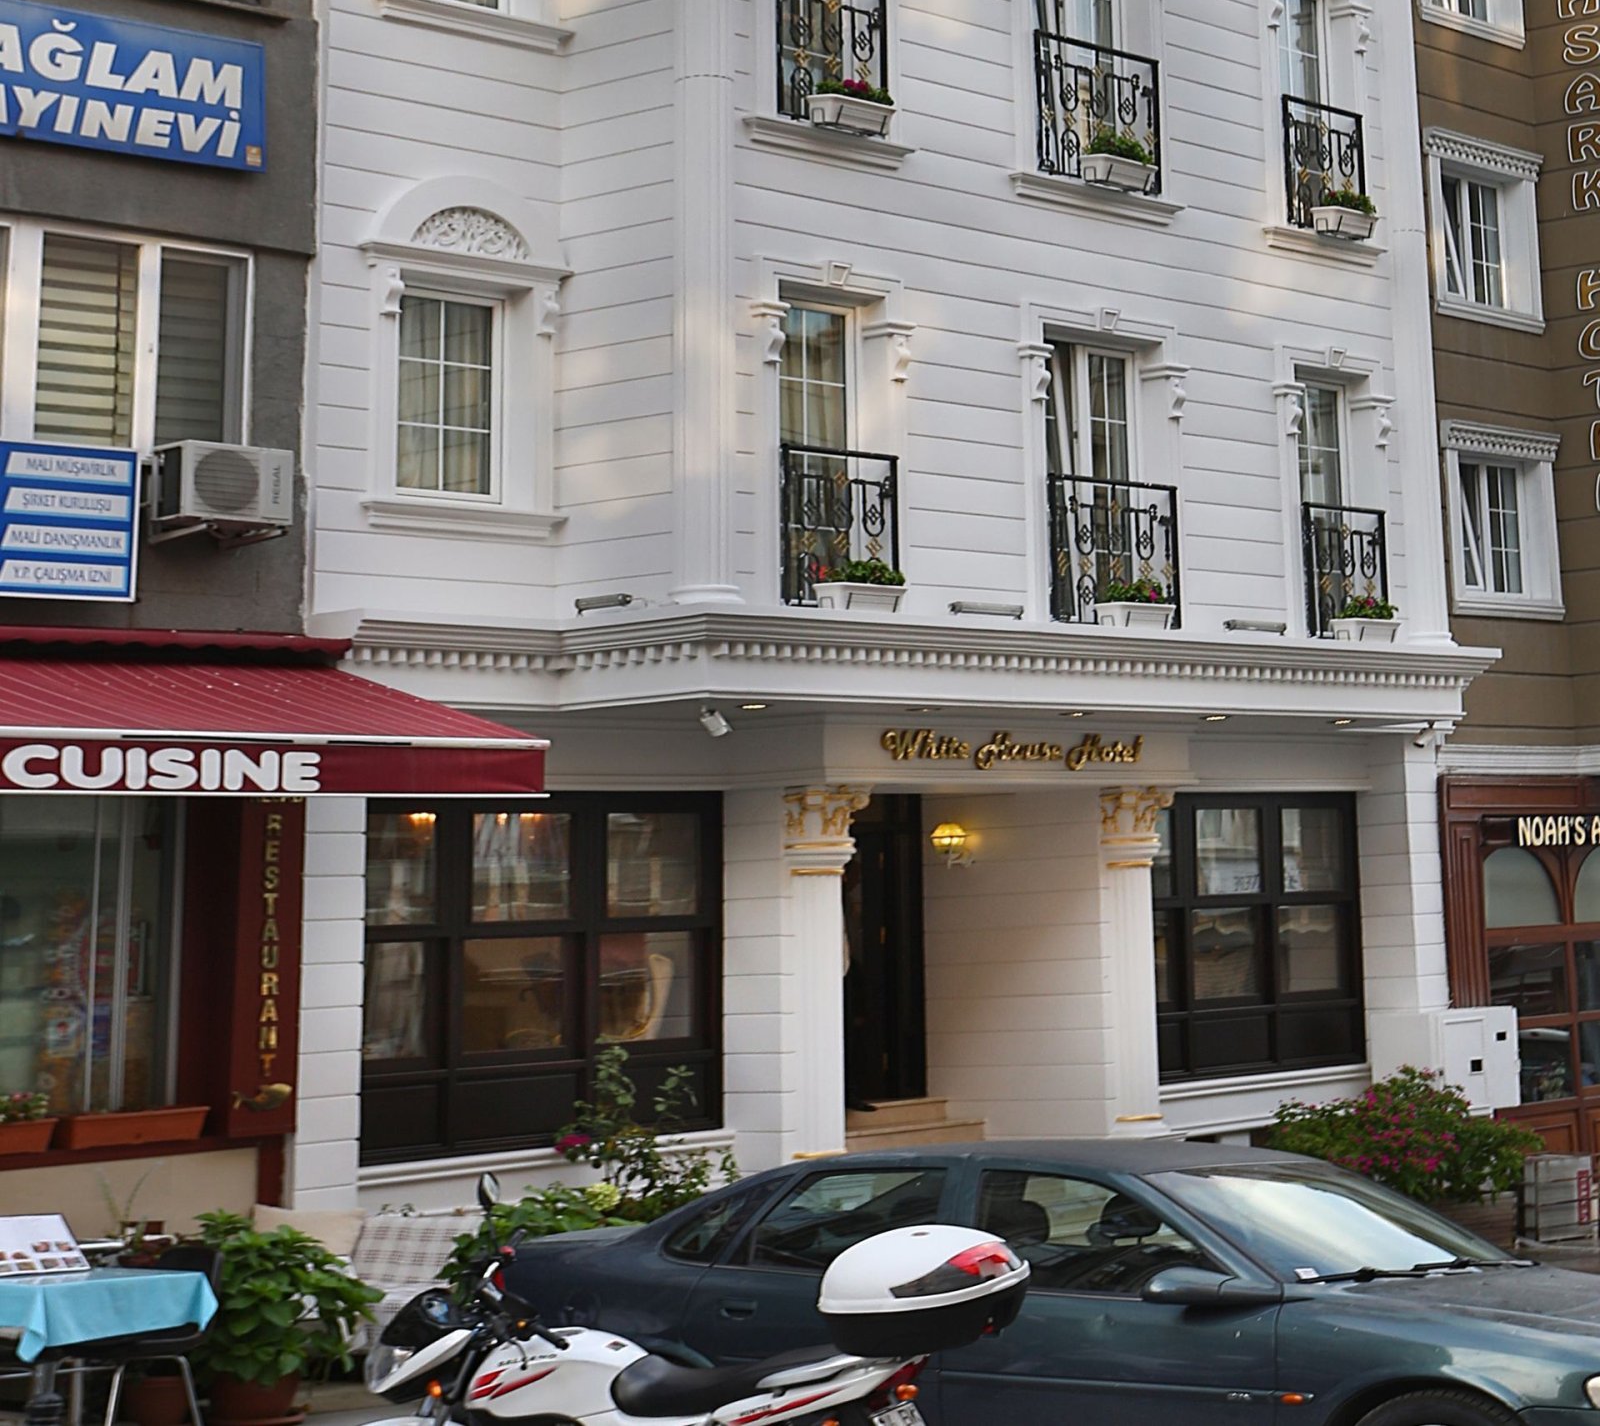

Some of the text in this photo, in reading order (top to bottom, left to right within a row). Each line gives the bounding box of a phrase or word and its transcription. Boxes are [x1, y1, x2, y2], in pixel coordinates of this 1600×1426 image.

[0, 84, 242, 159] YINEVİ
[271, 465, 281, 505] REGAL
[11, 529, 40, 544] MALİ
[2, 744, 321, 792] CUISINE
[881, 729, 1145, 771] White House Hotel
[1518, 815, 1586, 846] NOAH'S
[259, 813, 283, 1077] RESTAURANT
